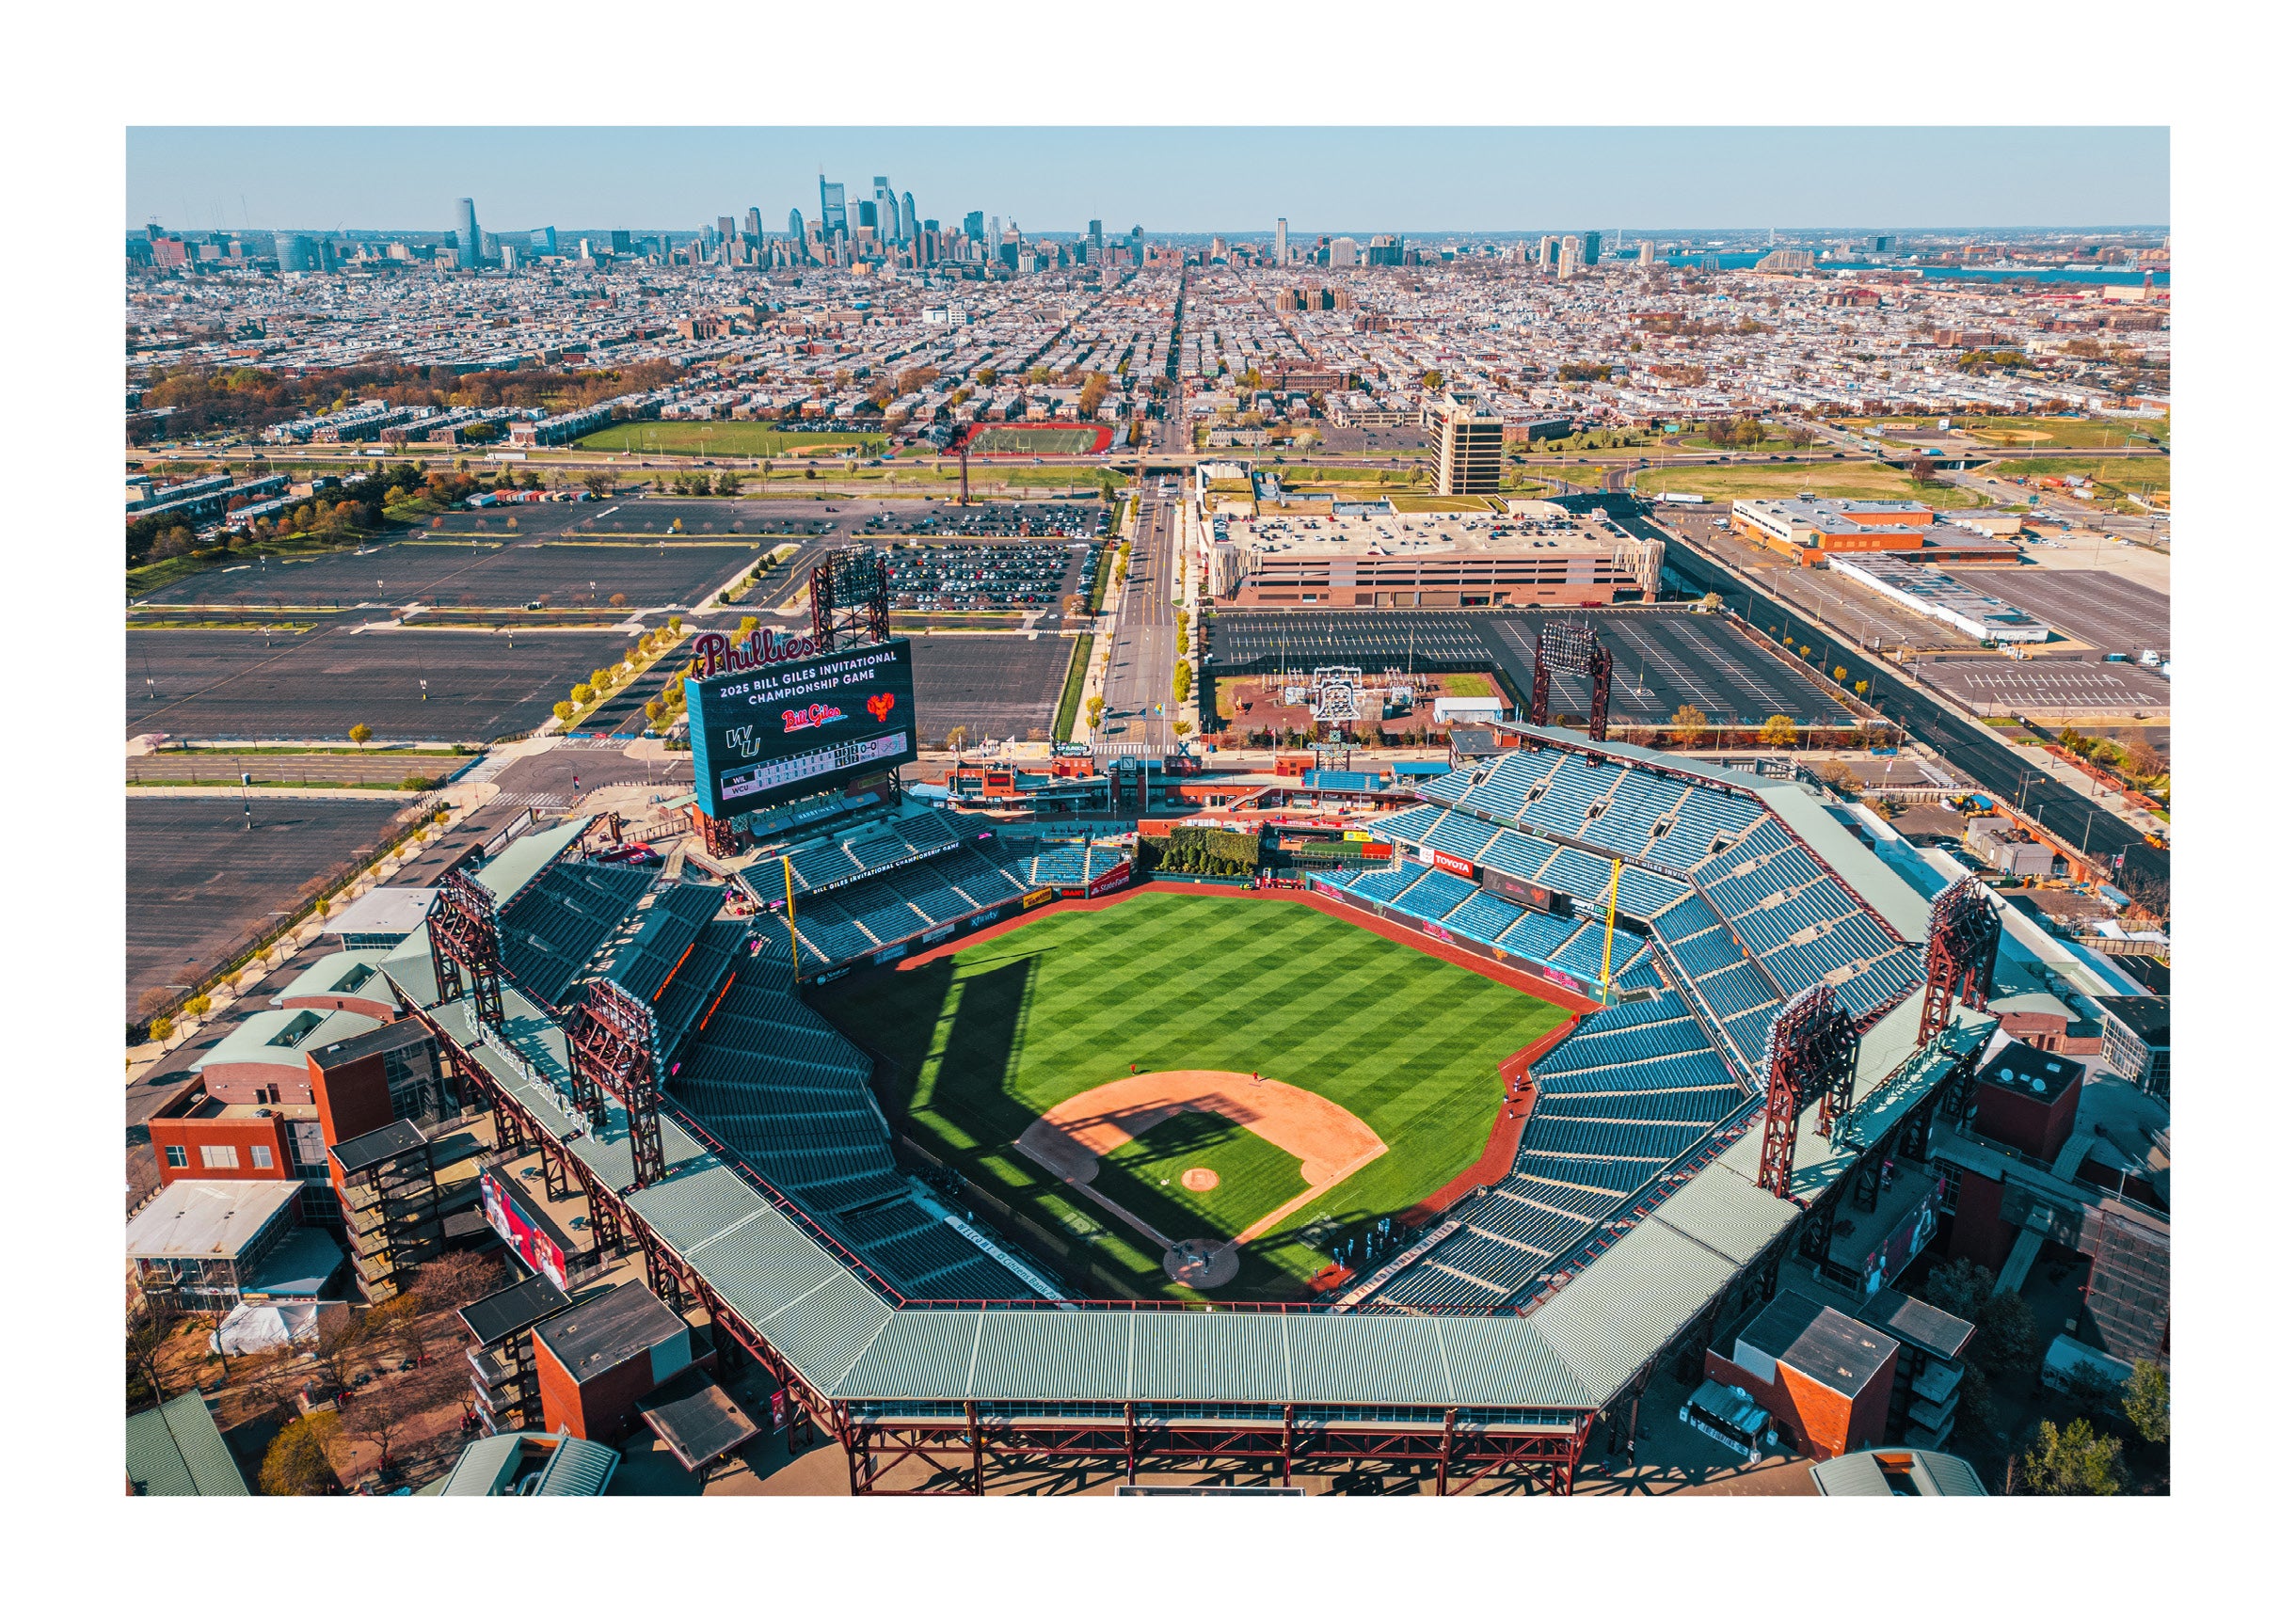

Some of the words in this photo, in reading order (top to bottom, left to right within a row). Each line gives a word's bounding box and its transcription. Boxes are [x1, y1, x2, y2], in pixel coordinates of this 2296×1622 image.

[693, 628, 817, 676] Phillies
[720, 683, 749, 698] 2025
[754, 677, 777, 692] BILL
[782, 669, 816, 686] GILES
[820, 651, 897, 676] INVITATIONAL
[749, 677, 839, 705] CHAMPIONSHIP
[843, 669, 874, 685] GAME
[782, 709, 807, 728] Bill
[807, 703, 841, 727] Giles
[732, 785, 749, 794] WCU
[733, 775, 746, 785] WIL
[813, 886, 827, 895] BILL
[829, 879, 848, 890] GILES
[850, 863, 894, 883] INVITATIONAL
[895, 849, 941, 867] CHAMPIONSHIP
[942, 842, 960, 851] GAME
[1435, 854, 1470, 873] TOYOTA
[1624, 856, 1639, 865] BILL
[1641, 860, 1663, 873] GILES
[971, 910, 1000, 927] xfinity
[479, 1021, 529, 1080] Citizens
[526, 1063, 563, 1114] Bank
[561, 1093, 596, 1143] Park
[957, 1223, 995, 1252] WELCOME
[1003, 1258, 1031, 1280] Citizens
[1028, 1277, 1048, 1295] Bank
[1353, 1251, 1416, 1298] PHILADELPHIA
[1417, 1224, 1455, 1252] PHILLIES
